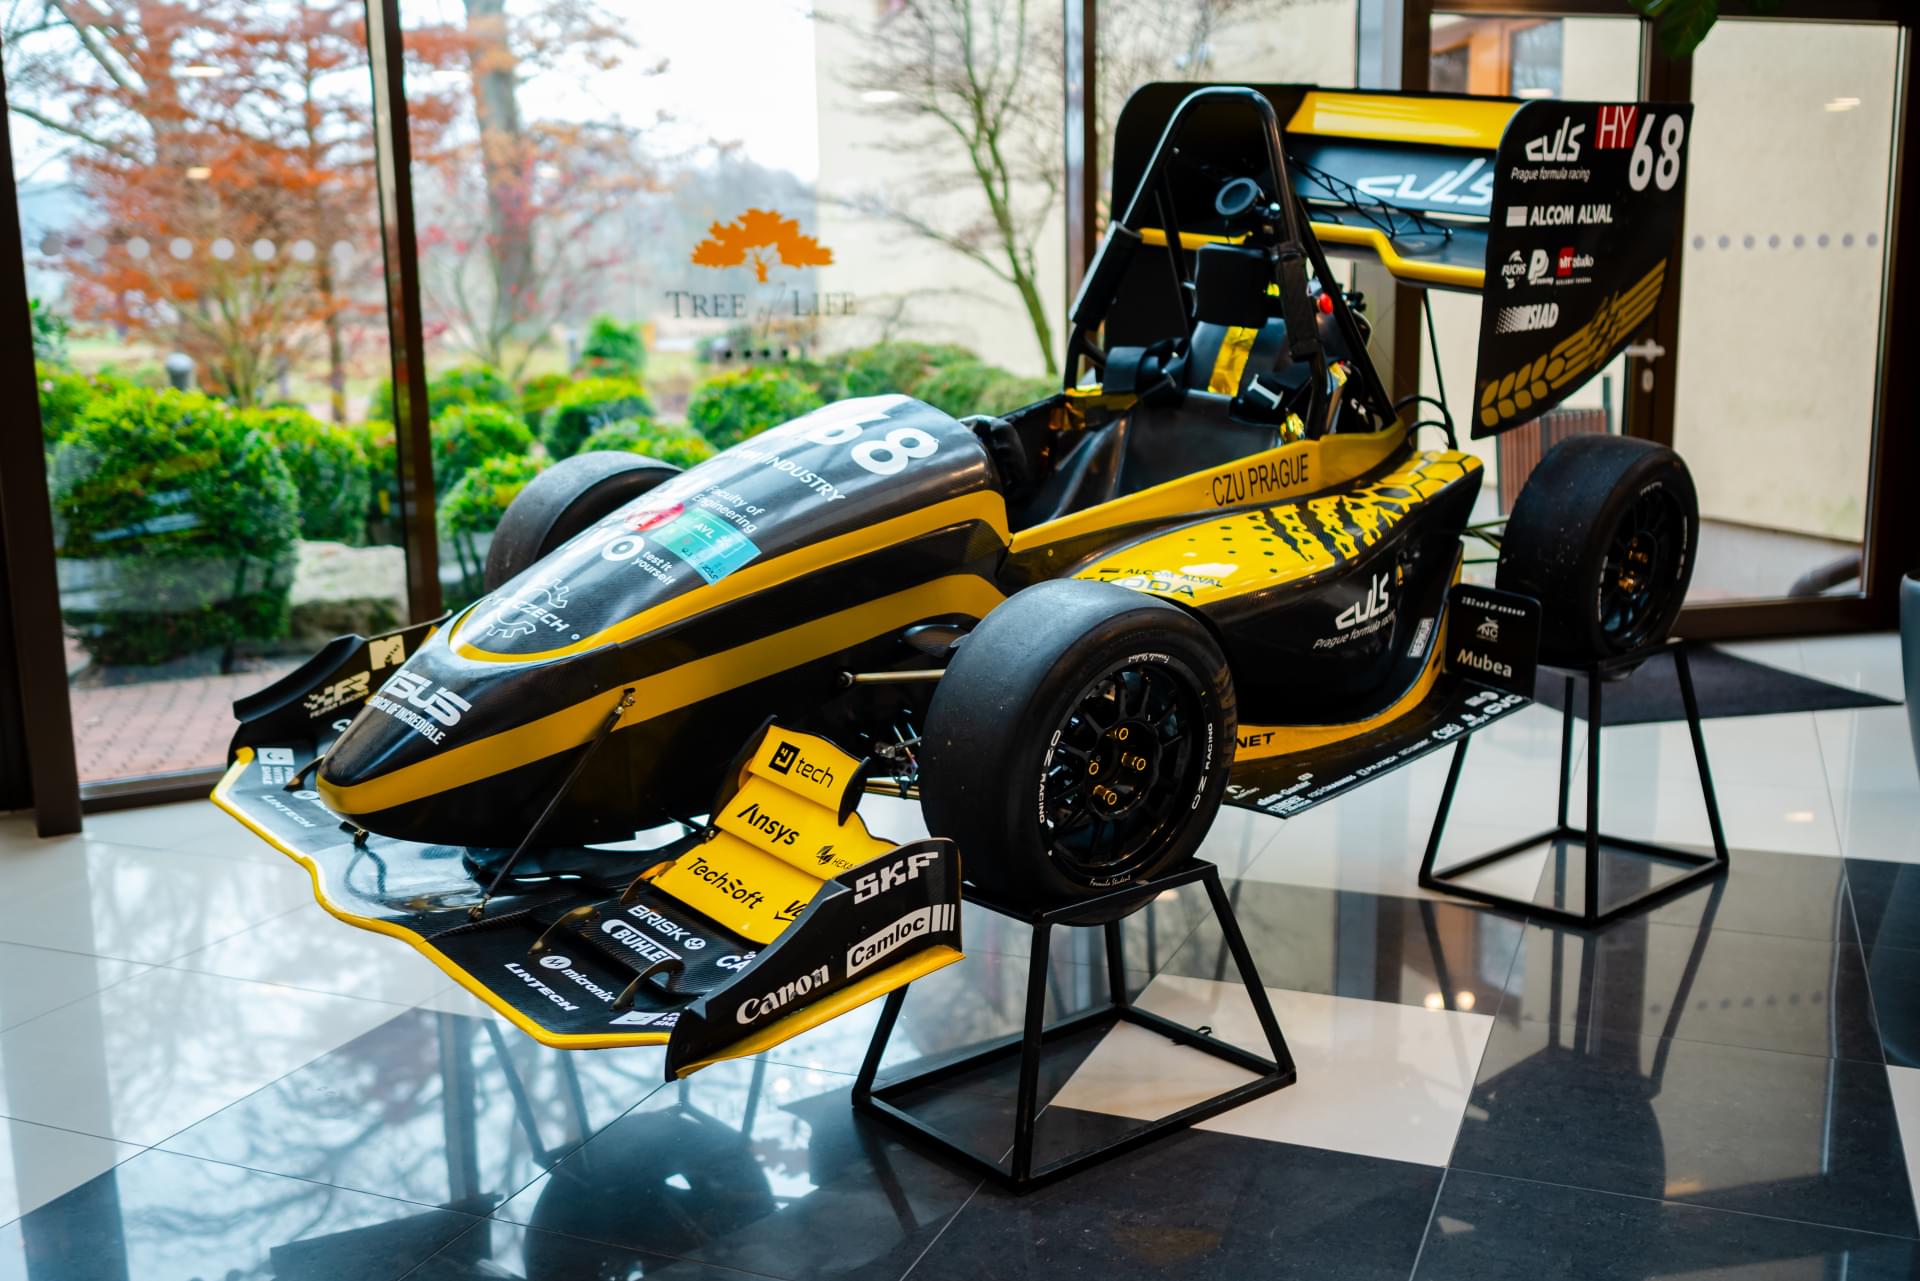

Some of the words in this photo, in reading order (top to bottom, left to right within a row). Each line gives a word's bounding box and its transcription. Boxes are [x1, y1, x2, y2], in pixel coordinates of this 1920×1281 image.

[1598, 105, 1637, 149] HY
[1628, 113, 1685, 192] 68
[1511, 166, 1538, 182] Prague
[1539, 166, 1567, 181] formula
[1568, 167, 1590, 182] racing
[1529, 205, 1574, 226] ALCOM
[1577, 204, 1613, 225] ALVAL
[1502, 263, 1527, 276] FUCHS
[1527, 303, 1560, 331] SIAD
[800, 406, 939, 476] 68
[1212, 476, 1245, 507] CZU
[1249, 453, 1309, 497] PRAGUE
[691, 493, 758, 535] Engineering
[706, 485, 748, 509] Faculty
[745, 505, 766, 516] of
[694, 523, 717, 539] AVL
[631, 557, 677, 585] yourself
[642, 551, 663, 566] test
[661, 559, 673, 572] it
[1180, 574, 1224, 588] ALVAL
[1312, 633, 1349, 650] Prague
[1350, 620, 1381, 640] formula
[1457, 648, 1512, 678] Mubea
[385, 702, 401, 715] OF
[394, 707, 446, 745] INCREDIBLE
[1205, 722, 1213, 771] RACING
[1039, 772, 1048, 824] RACING
[737, 803, 800, 846] Ansys
[687, 857, 765, 910] TechSoft
[854, 851, 940, 905] SKF
[627, 904, 692, 942] BRISK
[851, 915, 925, 968] Camloc
[611, 928, 674, 964] BUHLE
[504, 962, 581, 1012] LINTECH
[561, 968, 616, 1003] micronix
[736, 964, 830, 1026] Canon
